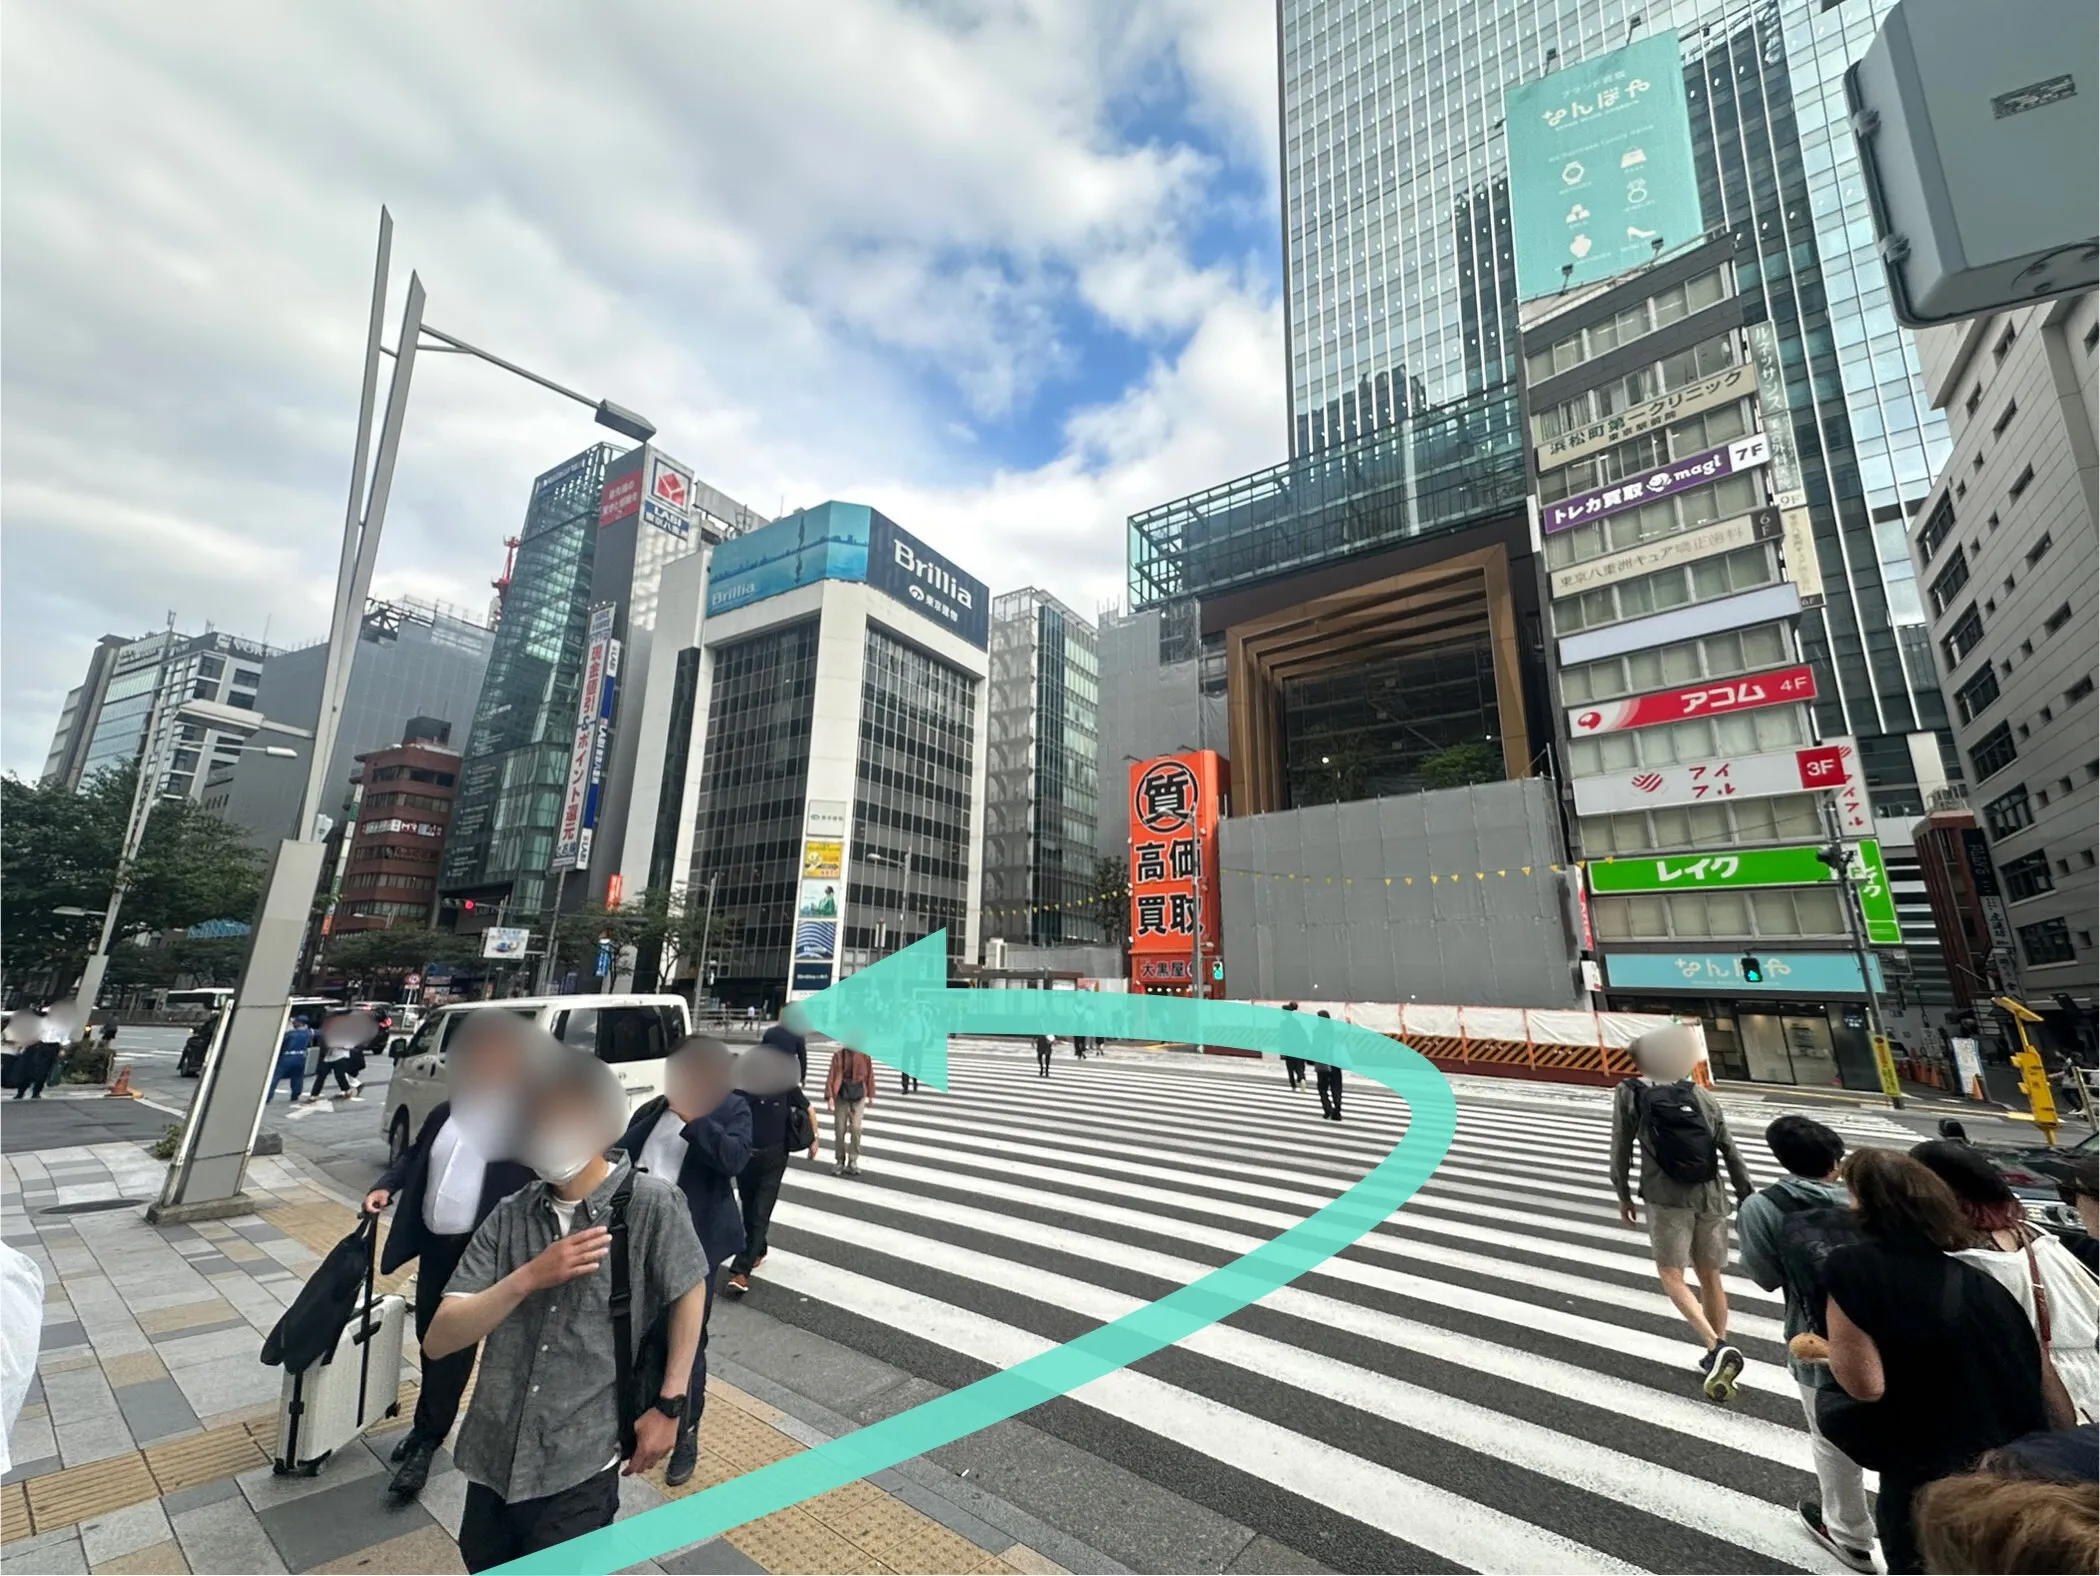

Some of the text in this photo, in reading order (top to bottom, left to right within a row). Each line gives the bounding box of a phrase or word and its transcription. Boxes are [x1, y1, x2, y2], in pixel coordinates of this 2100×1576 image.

[1542, 79, 1650, 127] なんぼや
[1754, 327, 1782, 410] ルネッサンス
[1550, 371, 1742, 456] 浜松町第一クリニック
[1735, 442, 1763, 461] 7F
[1555, 454, 1723, 525] トレカ買取 magi
[654, 506, 681, 526] LABI
[894, 539, 972, 609] Brillia
[712, 583, 755, 606] Brillia
[1681, 683, 1766, 714] アコム
[1780, 676, 1808, 691] 4F
[1807, 759, 1834, 777] 3F
[1141, 768, 1191, 823] 質
[1135, 839, 1201, 883] 高価
[1656, 856, 1739, 881] レイク
[1136, 893, 1204, 936] 買取
[1142, 960, 1186, 978] 大黒屋
